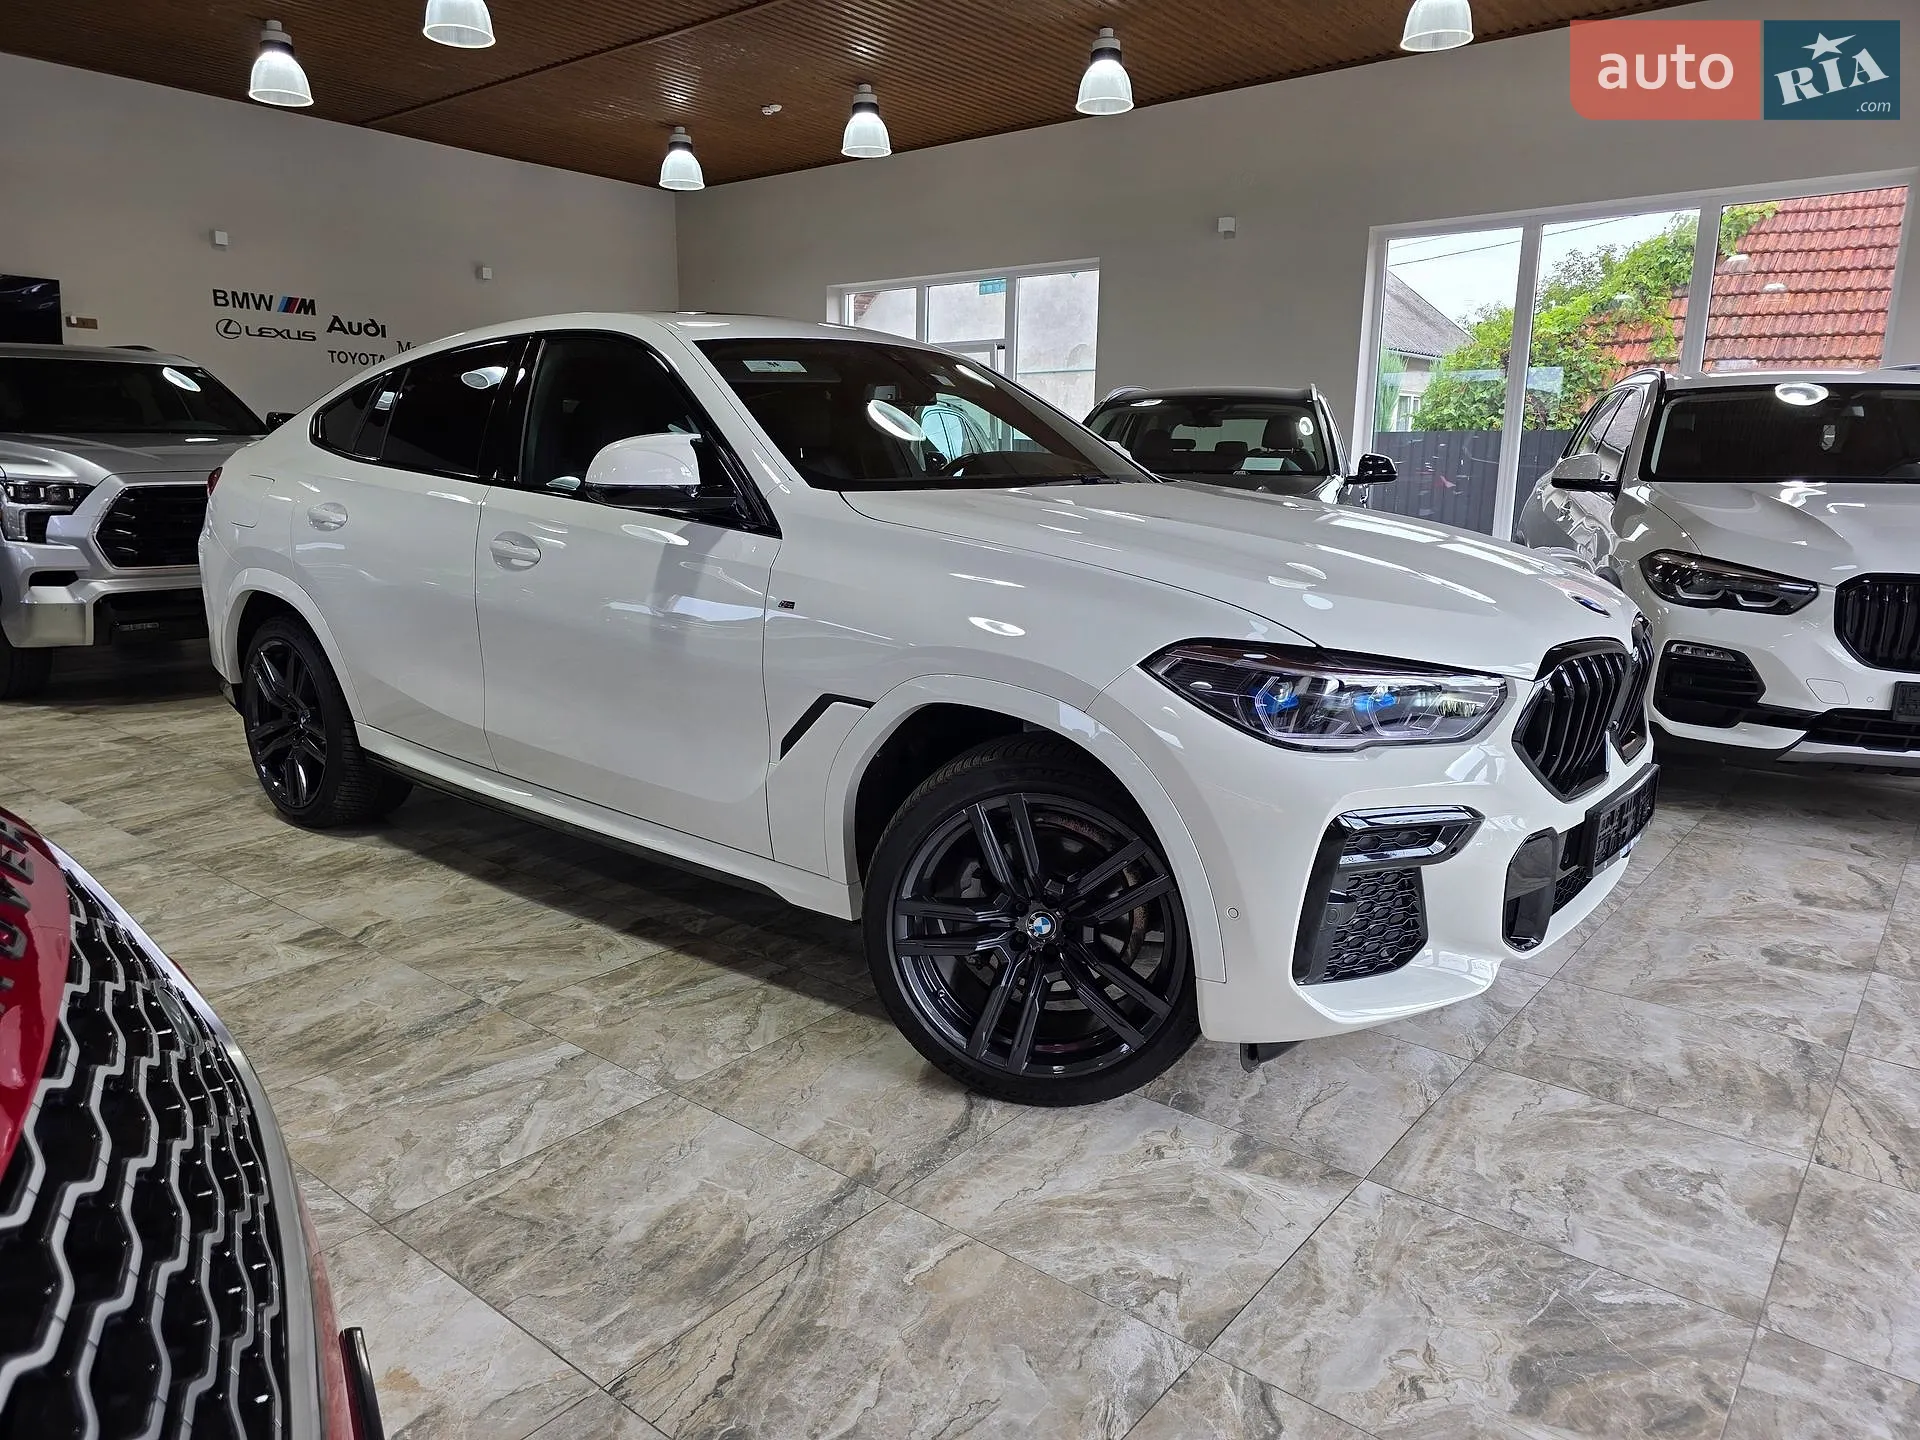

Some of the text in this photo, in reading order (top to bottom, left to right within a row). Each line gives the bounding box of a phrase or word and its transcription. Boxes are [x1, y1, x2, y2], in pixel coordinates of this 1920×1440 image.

[212, 289, 274, 312] BMW
[245, 325, 317, 342] LEXUS
[326, 314, 387, 338] Audi
